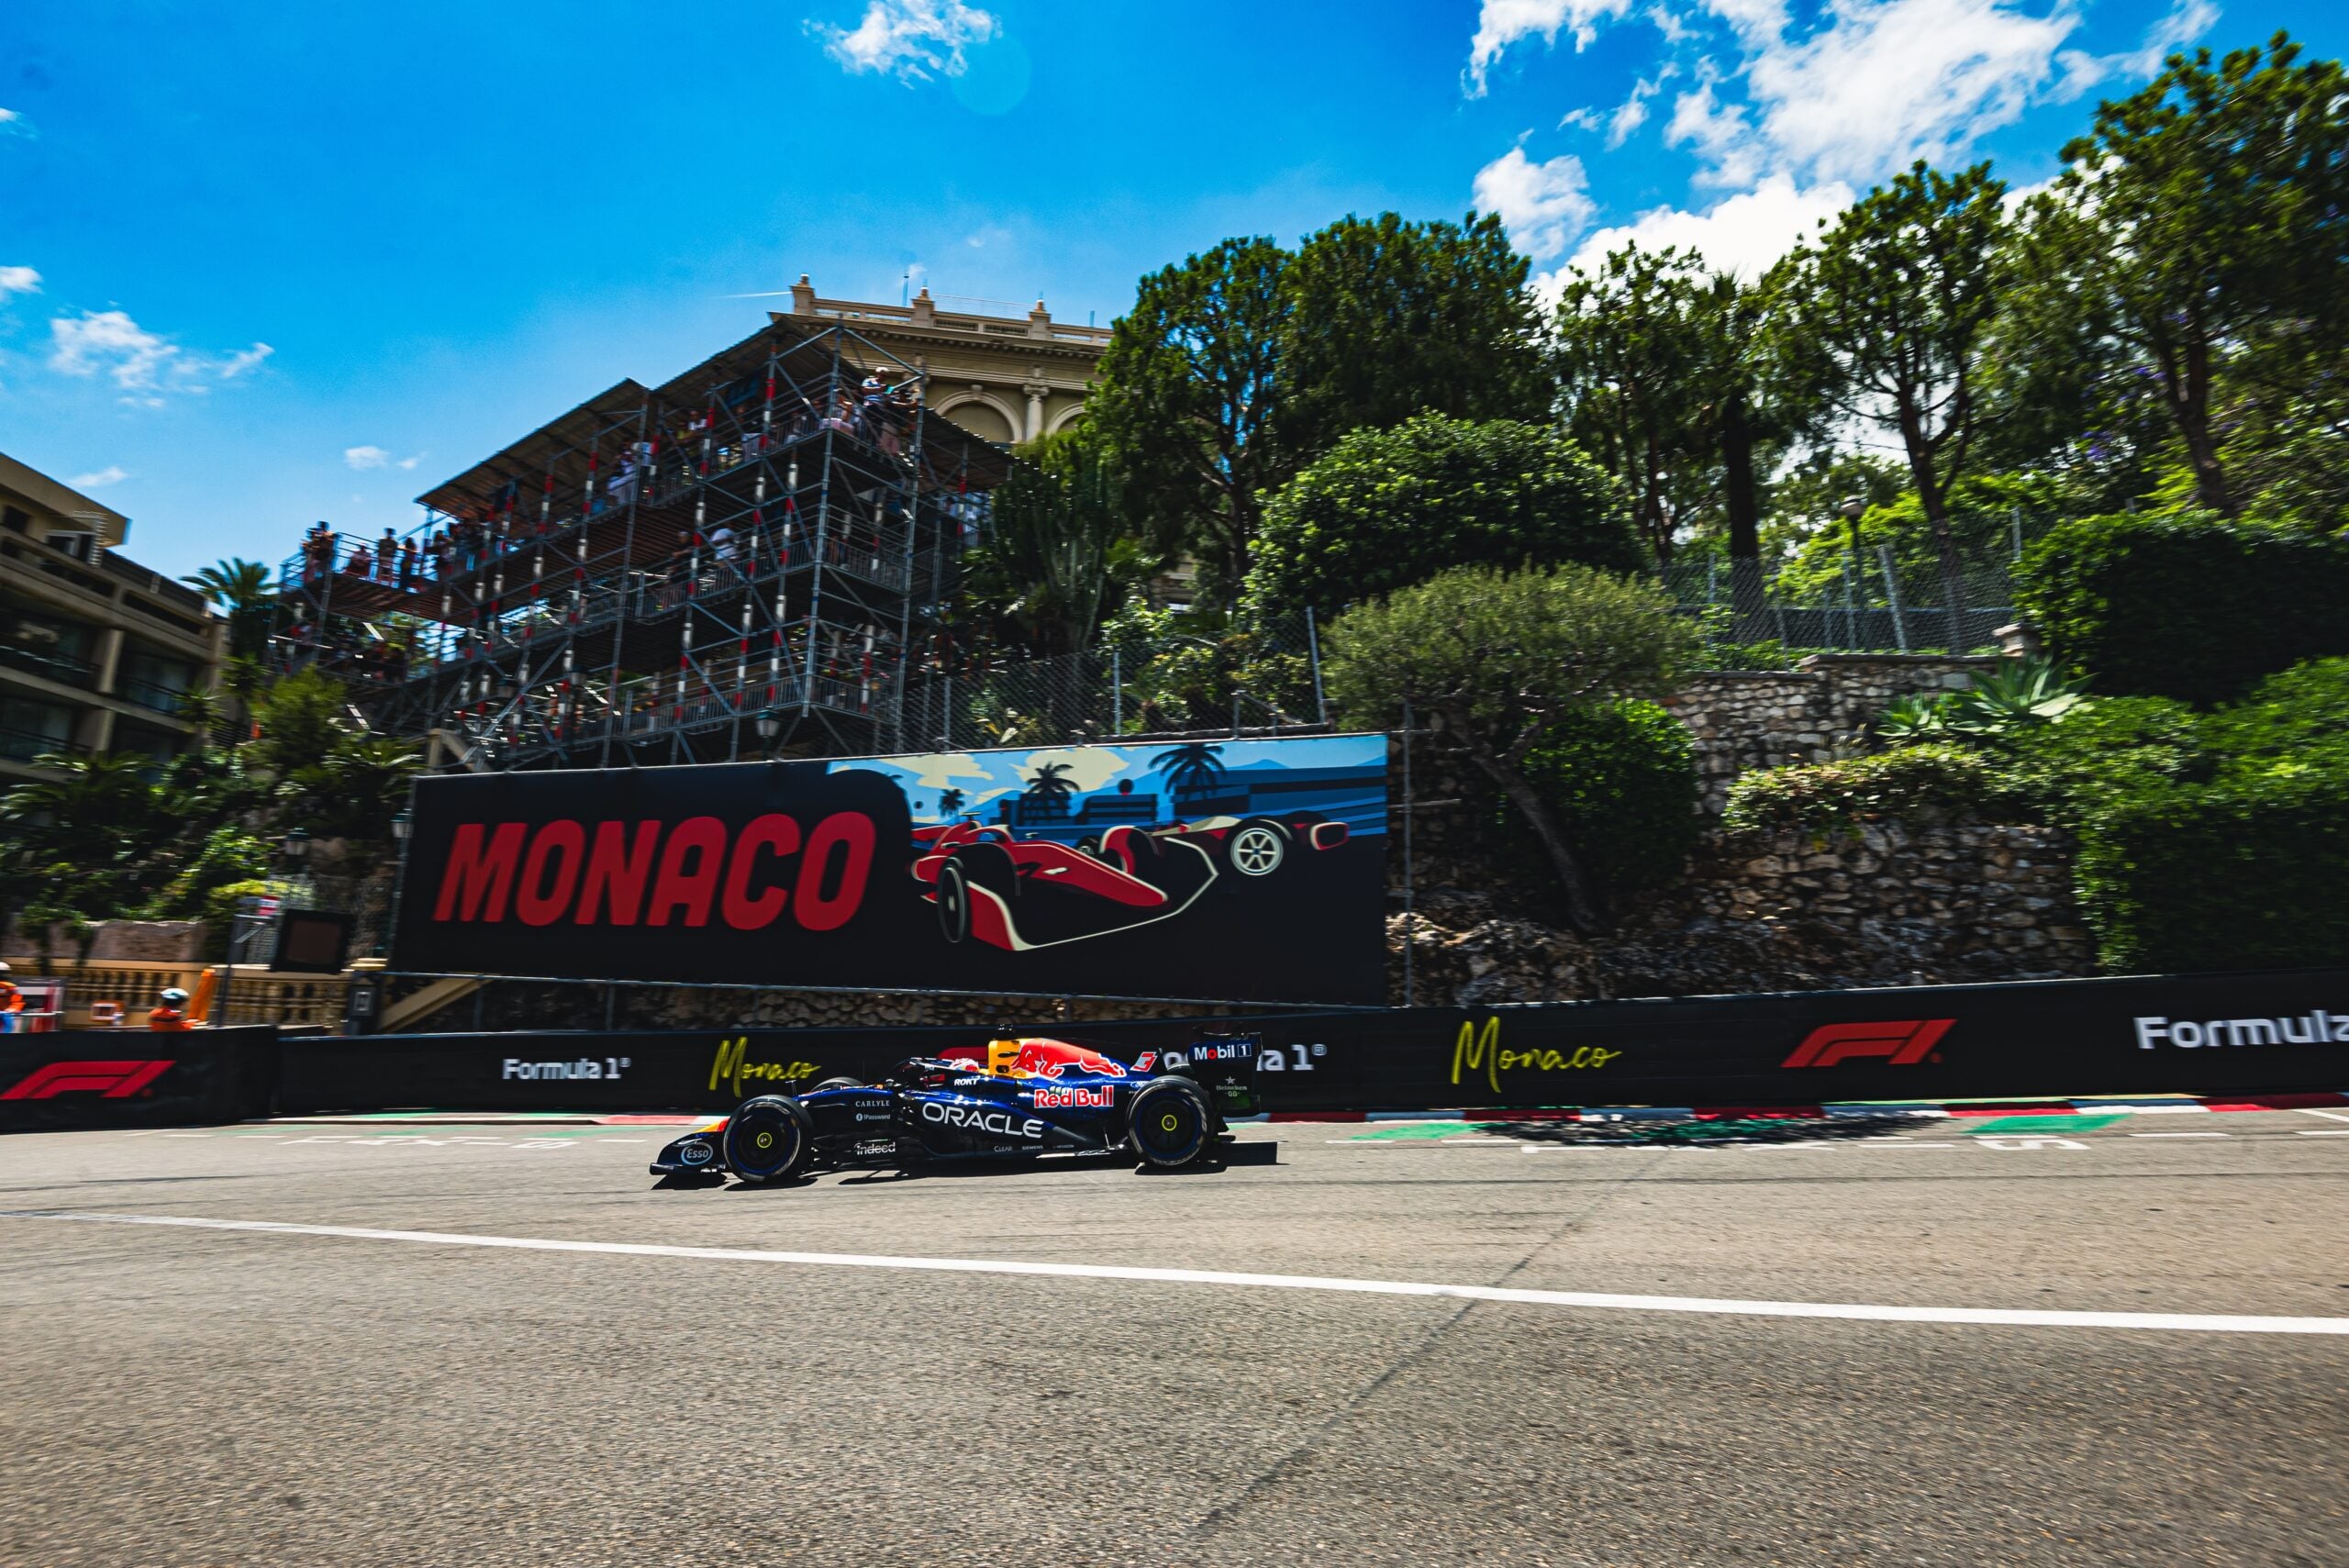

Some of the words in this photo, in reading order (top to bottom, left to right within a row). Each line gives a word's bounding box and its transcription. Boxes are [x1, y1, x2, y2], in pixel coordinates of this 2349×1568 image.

[436, 811, 876, 931] MONACO
[1194, 1046, 1235, 1061] Mobil
[1452, 1016, 1622, 1092] Monaco
[1781, 1018, 1957, 1068] F1
[502, 1058, 602, 1080] Formula
[708, 1037, 821, 1097] Monaco
[1130, 1051, 1158, 1072] 3
[953, 1075, 980, 1086] ROKT
[1034, 1087, 1074, 1108] Red
[1074, 1084, 1114, 1107] Bull
[922, 1102, 1044, 1139] ORACLE
[855, 1141, 896, 1156] indeed
